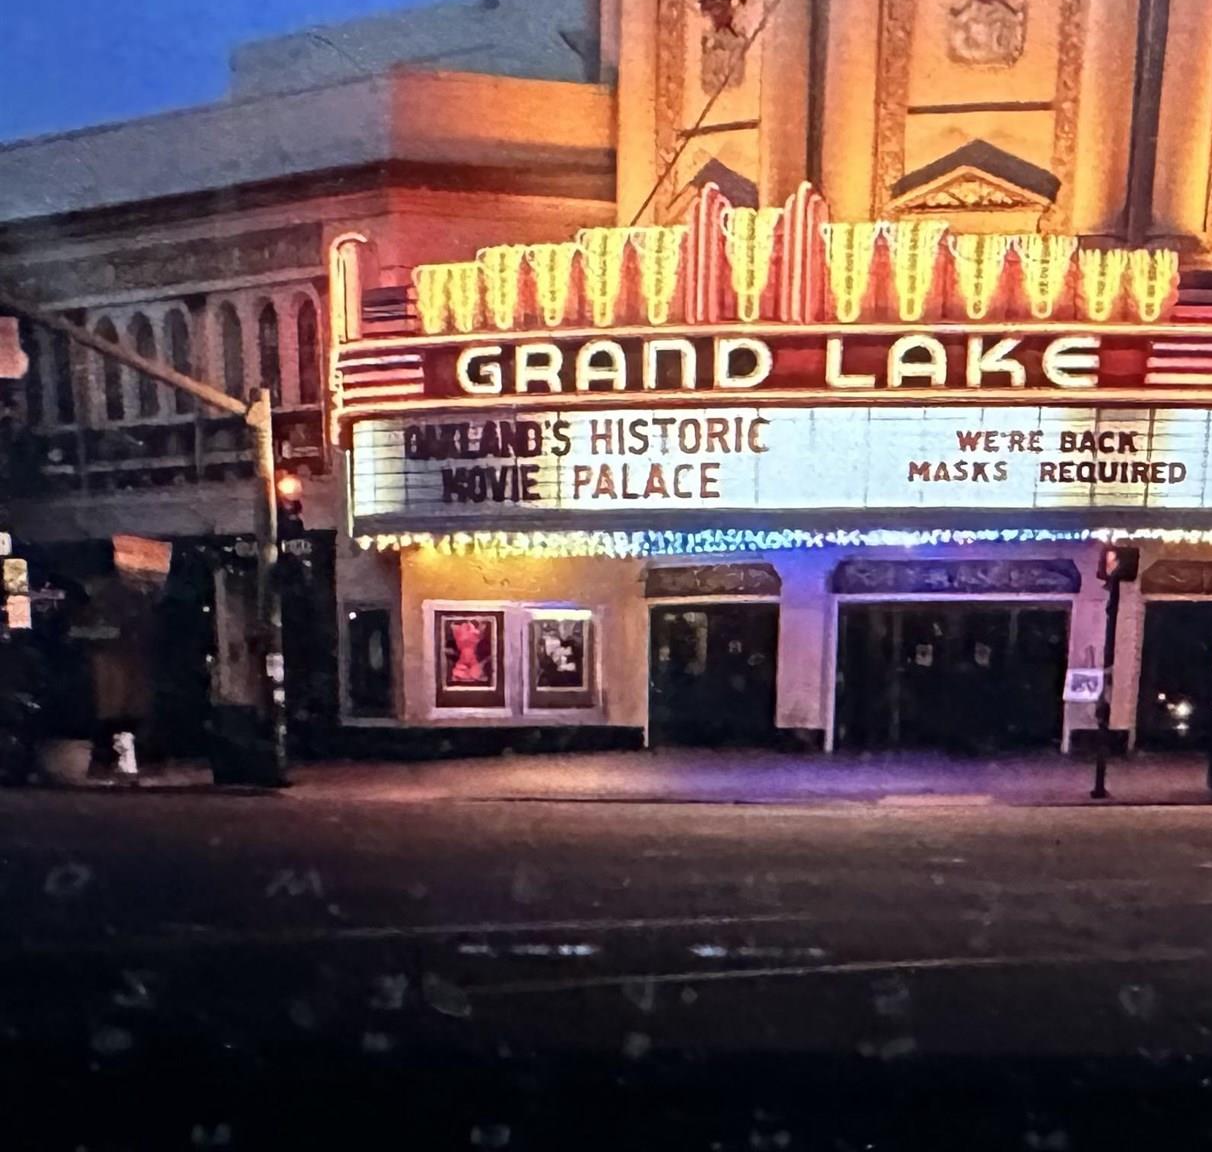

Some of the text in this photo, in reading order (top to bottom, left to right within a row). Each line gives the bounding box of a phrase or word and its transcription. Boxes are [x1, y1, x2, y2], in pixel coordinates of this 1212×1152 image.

[456, 335, 1100, 394] GRAND LAKE
[590, 416, 771, 455] HISTORIC
[956, 430, 1138, 453] WE'RE BACK
[573, 462, 720, 499] PALACE
[907, 460, 1187, 483] MASKS REQUIRED
